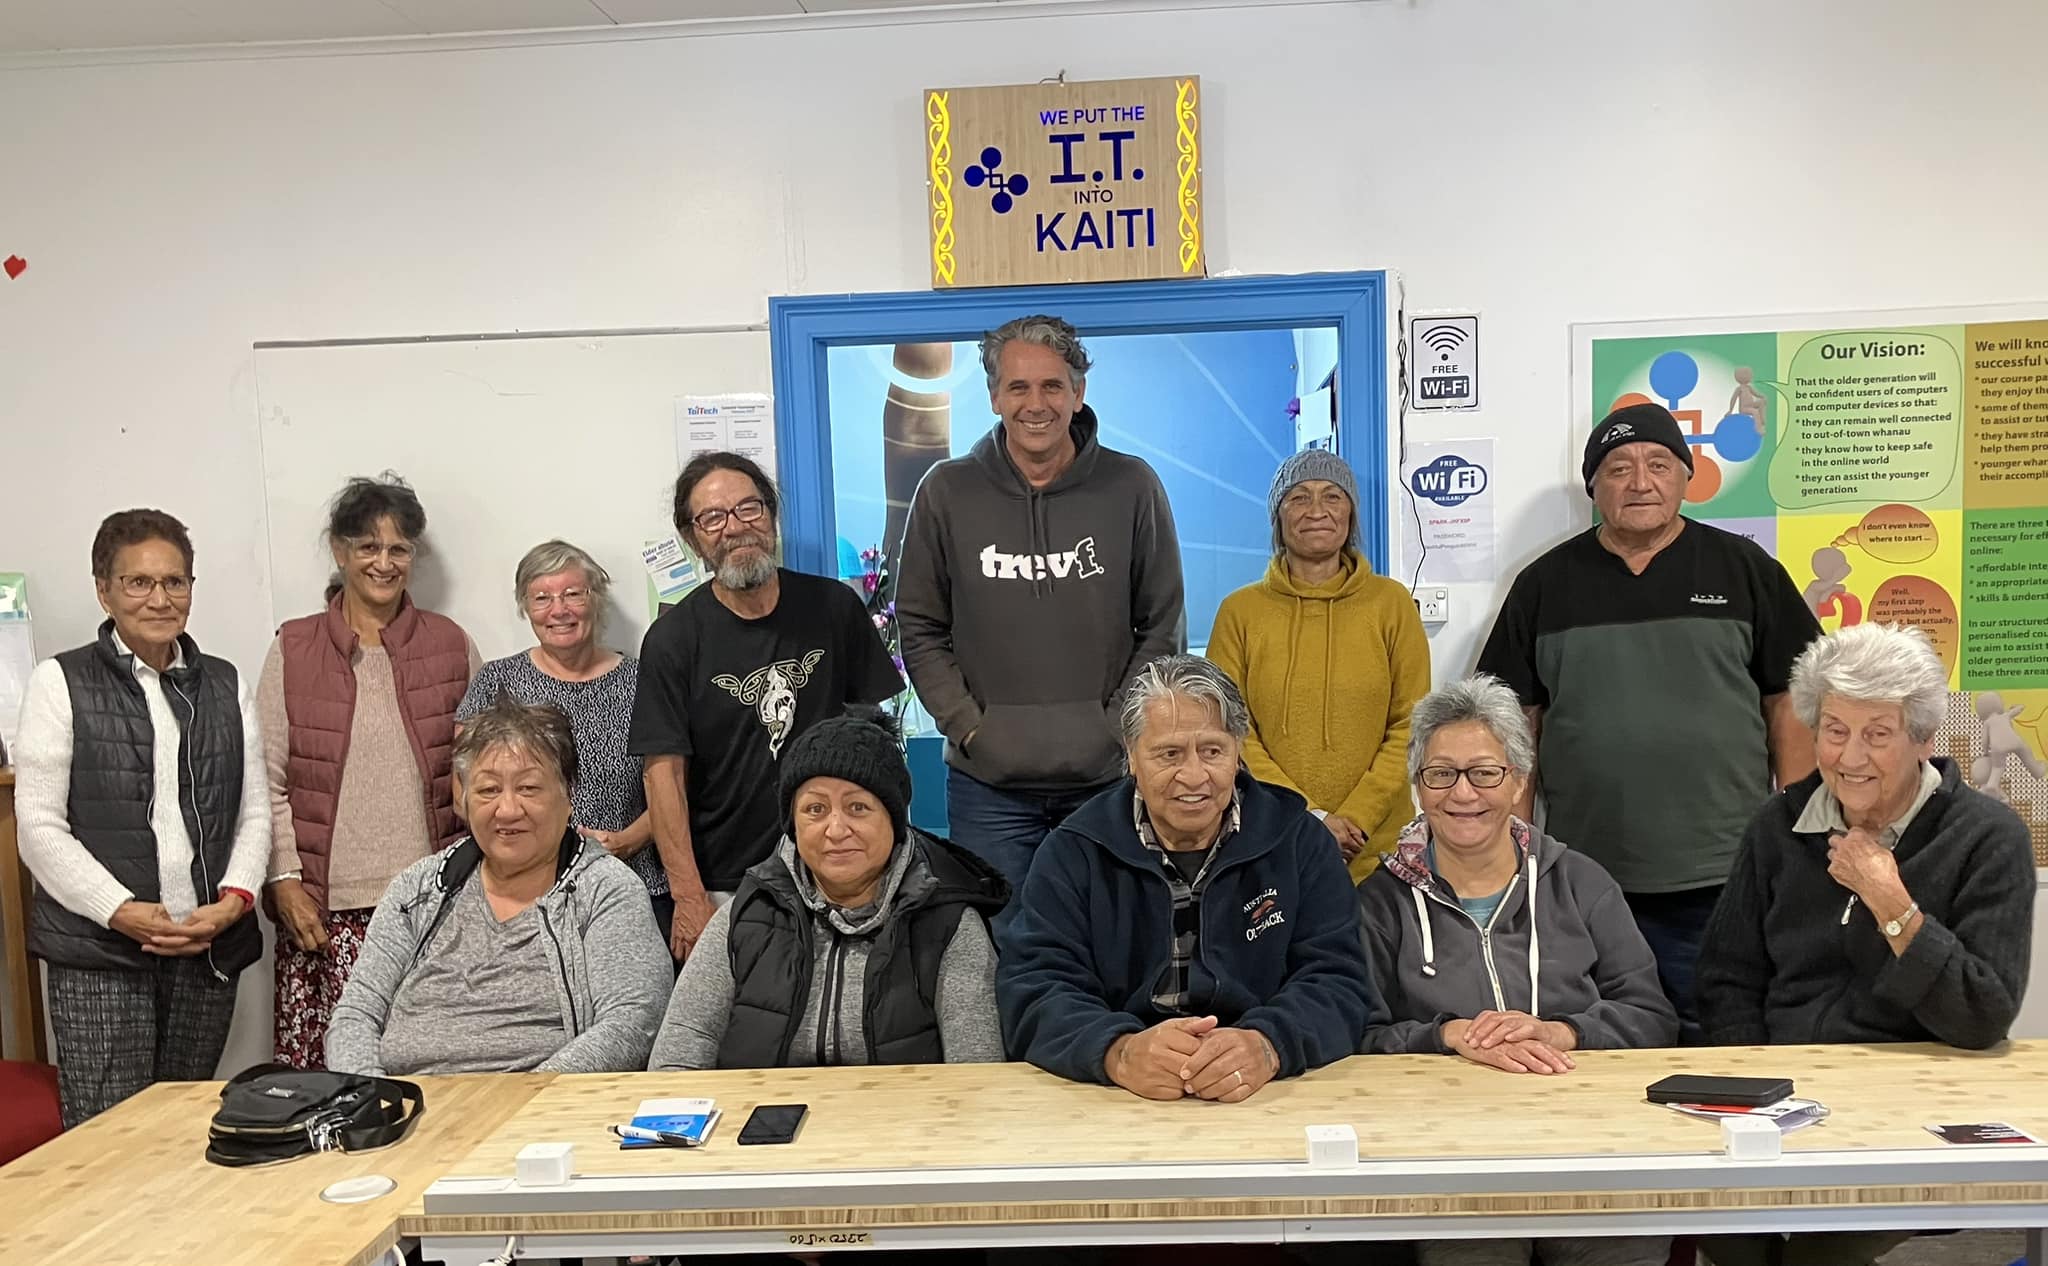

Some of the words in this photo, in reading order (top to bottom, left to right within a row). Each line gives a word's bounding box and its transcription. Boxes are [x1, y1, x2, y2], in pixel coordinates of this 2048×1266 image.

[1040, 110, 1068, 126] WE
[1074, 108, 1107, 124] PUT
[1112, 106, 1145, 121] THE
[1048, 130, 1144, 184] I.T.
[1074, 189, 1113, 204] INTO
[1036, 208, 1155, 252] KAITI
[1821, 344, 1856, 360] Our
[1860, 341, 1925, 358] Vision:
[1975, 341, 1995, 352] We
[1998, 338, 2022, 350] will
[1975, 354, 2040, 368] successful
[1432, 365, 1458, 374] FREE
[1796, 378, 1816, 386] That
[1819, 377, 1834, 386] the
[1836, 376, 1861, 384] older
[1864, 374, 1916, 386] generation
[1918, 372, 1936, 380] will
[2000, 376, 2033, 384] course
[1423, 380, 1467, 396] Wi-Fi
[1796, 390, 1808, 399] be
[1810, 388, 1854, 398] confident
[1856, 388, 1882, 396] users
[1884, 387, 1894, 396] of
[1896, 386, 1948, 397] computers
[1981, 388, 2002, 398] they
[2006, 387, 2032, 397] enjoy
[1796, 403, 1814, 412] and
[1816, 400, 1861, 412] computer
[1863, 400, 1900, 409] devices
[2010, 402, 2020, 410] of
[1802, 418, 1823, 428] they
[1844, 417, 1876, 426] remain
[1878, 415, 1898, 424] well
[1900, 413, 1952, 423] connected
[1993, 416, 2020, 424] assist
[1802, 432, 1812, 440] to
[1814, 430, 1870, 438] out-of-town
[1872, 428, 1911, 436] whanau
[1981, 432, 2002, 441] they
[2005, 431, 2028, 439] have
[1802, 446, 1823, 456] they
[1824, 444, 1850, 454] know
[1852, 444, 1873, 452] how
[1888, 442, 1910, 453] keep
[1912, 441, 1933, 450] safe
[1980, 444, 2002, 454] help
[2004, 444, 2030, 452] them
[1802, 459, 1810, 467] in
[1812, 458, 1828, 466] the
[1830, 456, 1860, 466] online
[1862, 456, 1889, 464] world
[1980, 460, 2022, 470] younger
[1802, 474, 1823, 484] they
[1843, 472, 1869, 480] assist
[1871, 471, 1886, 480] the
[1889, 470, 1930, 480] younger
[1980, 472, 2003, 480] their
[1801, 486, 1858, 497] generations
[1970, 522, 1998, 530] There
[2018, 520, 2044, 528] three
[1970, 534, 2018, 542] necessary
[2020, 532, 2034, 540] for
[1976, 563, 2026, 572] affordable
[1990, 578, 2048, 588] appropriate
[1976, 594, 2000, 602] skills
[1892, 608, 1927, 616] probably
[1968, 630, 2030, 642] personalised
[2016, 642, 2043, 650] assist
[1968, 656, 1992, 664] older
[1968, 670, 1994, 678] these
[1996, 668, 2022, 676] three
